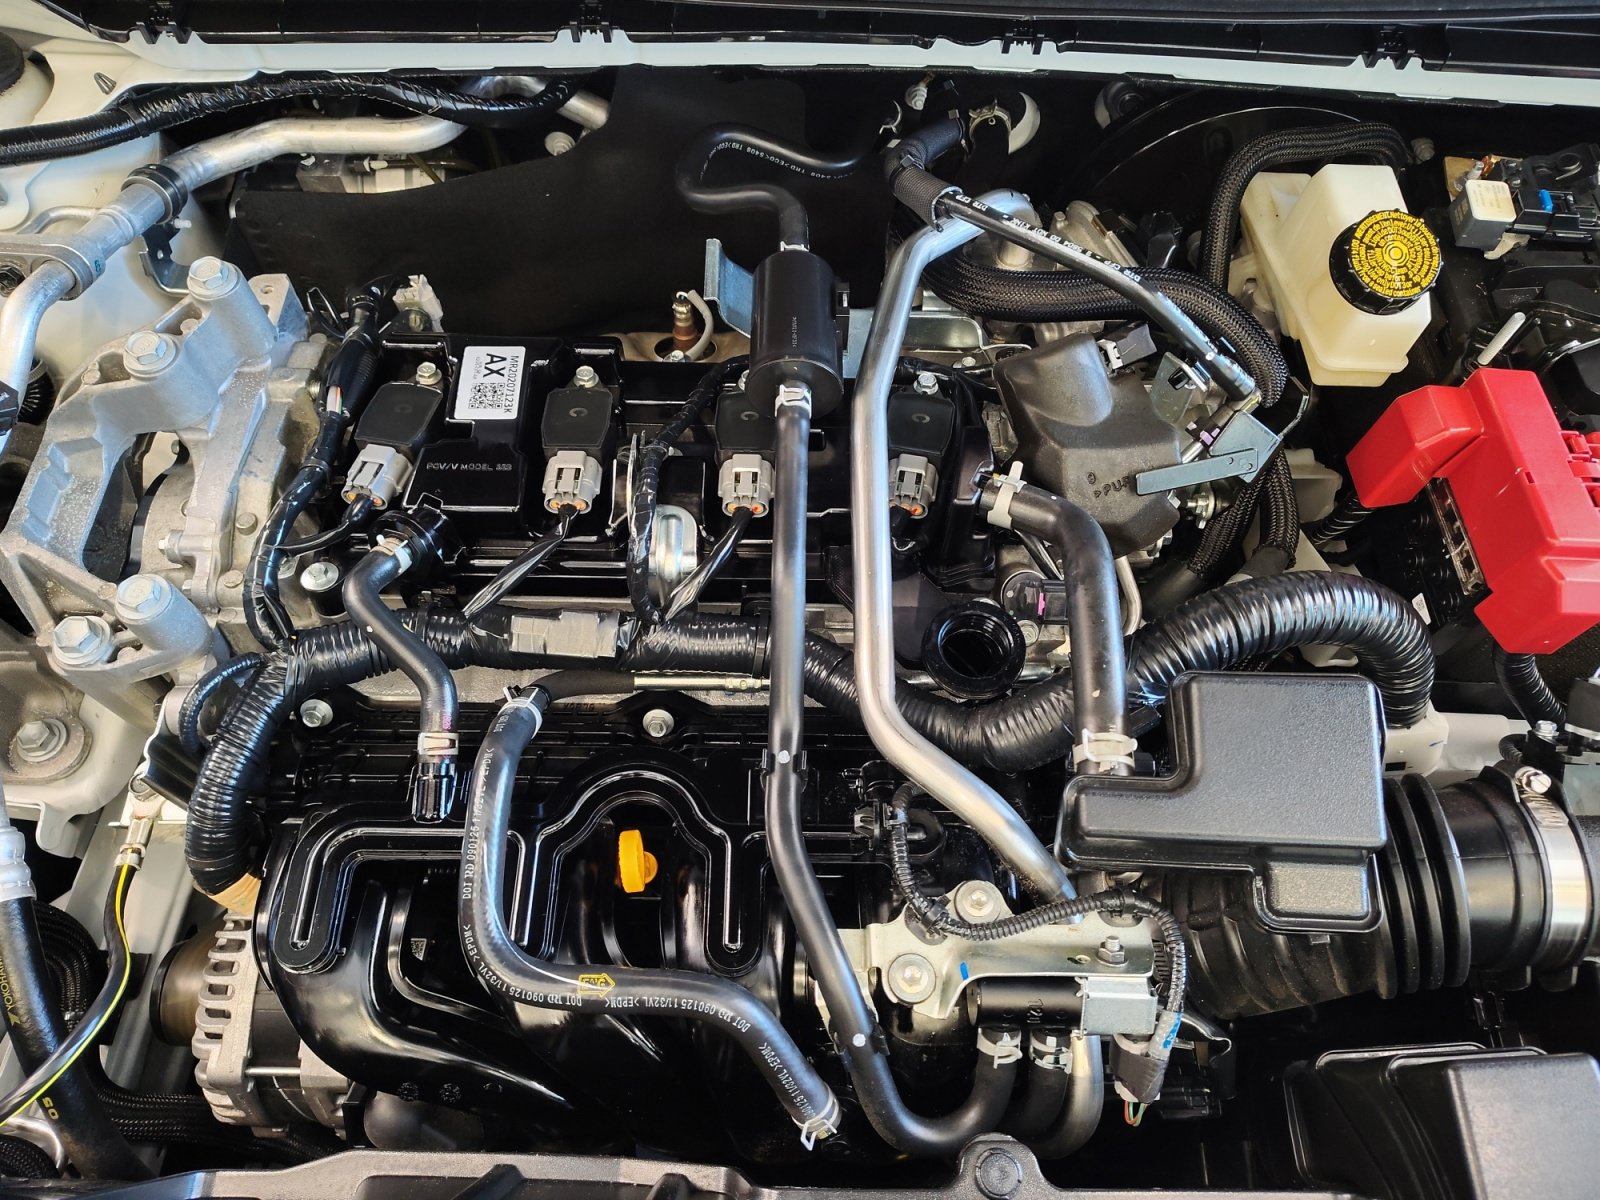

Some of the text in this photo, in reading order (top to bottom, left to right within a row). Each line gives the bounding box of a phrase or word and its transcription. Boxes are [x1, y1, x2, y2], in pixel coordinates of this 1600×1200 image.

[955, 194, 972, 204] CFP
[972, 201, 989, 212] DTR
[1012, 217, 1031, 230] KINK
[1033, 226, 1049, 238] NOT
[1103, 259, 1121, 271] CFP
[1123, 268, 1142, 283] DTR
[482, 352, 507, 378] AX
[503, 355, 520, 414] MR20207123K
[466, 825, 480, 861] 090125
[462, 881, 473, 899] DOT
[508, 986, 544, 1003] 090125
[565, 994, 582, 1007] DOT
[680, 999, 716, 1015] 090125
[732, 1016, 751, 1033] DOT
